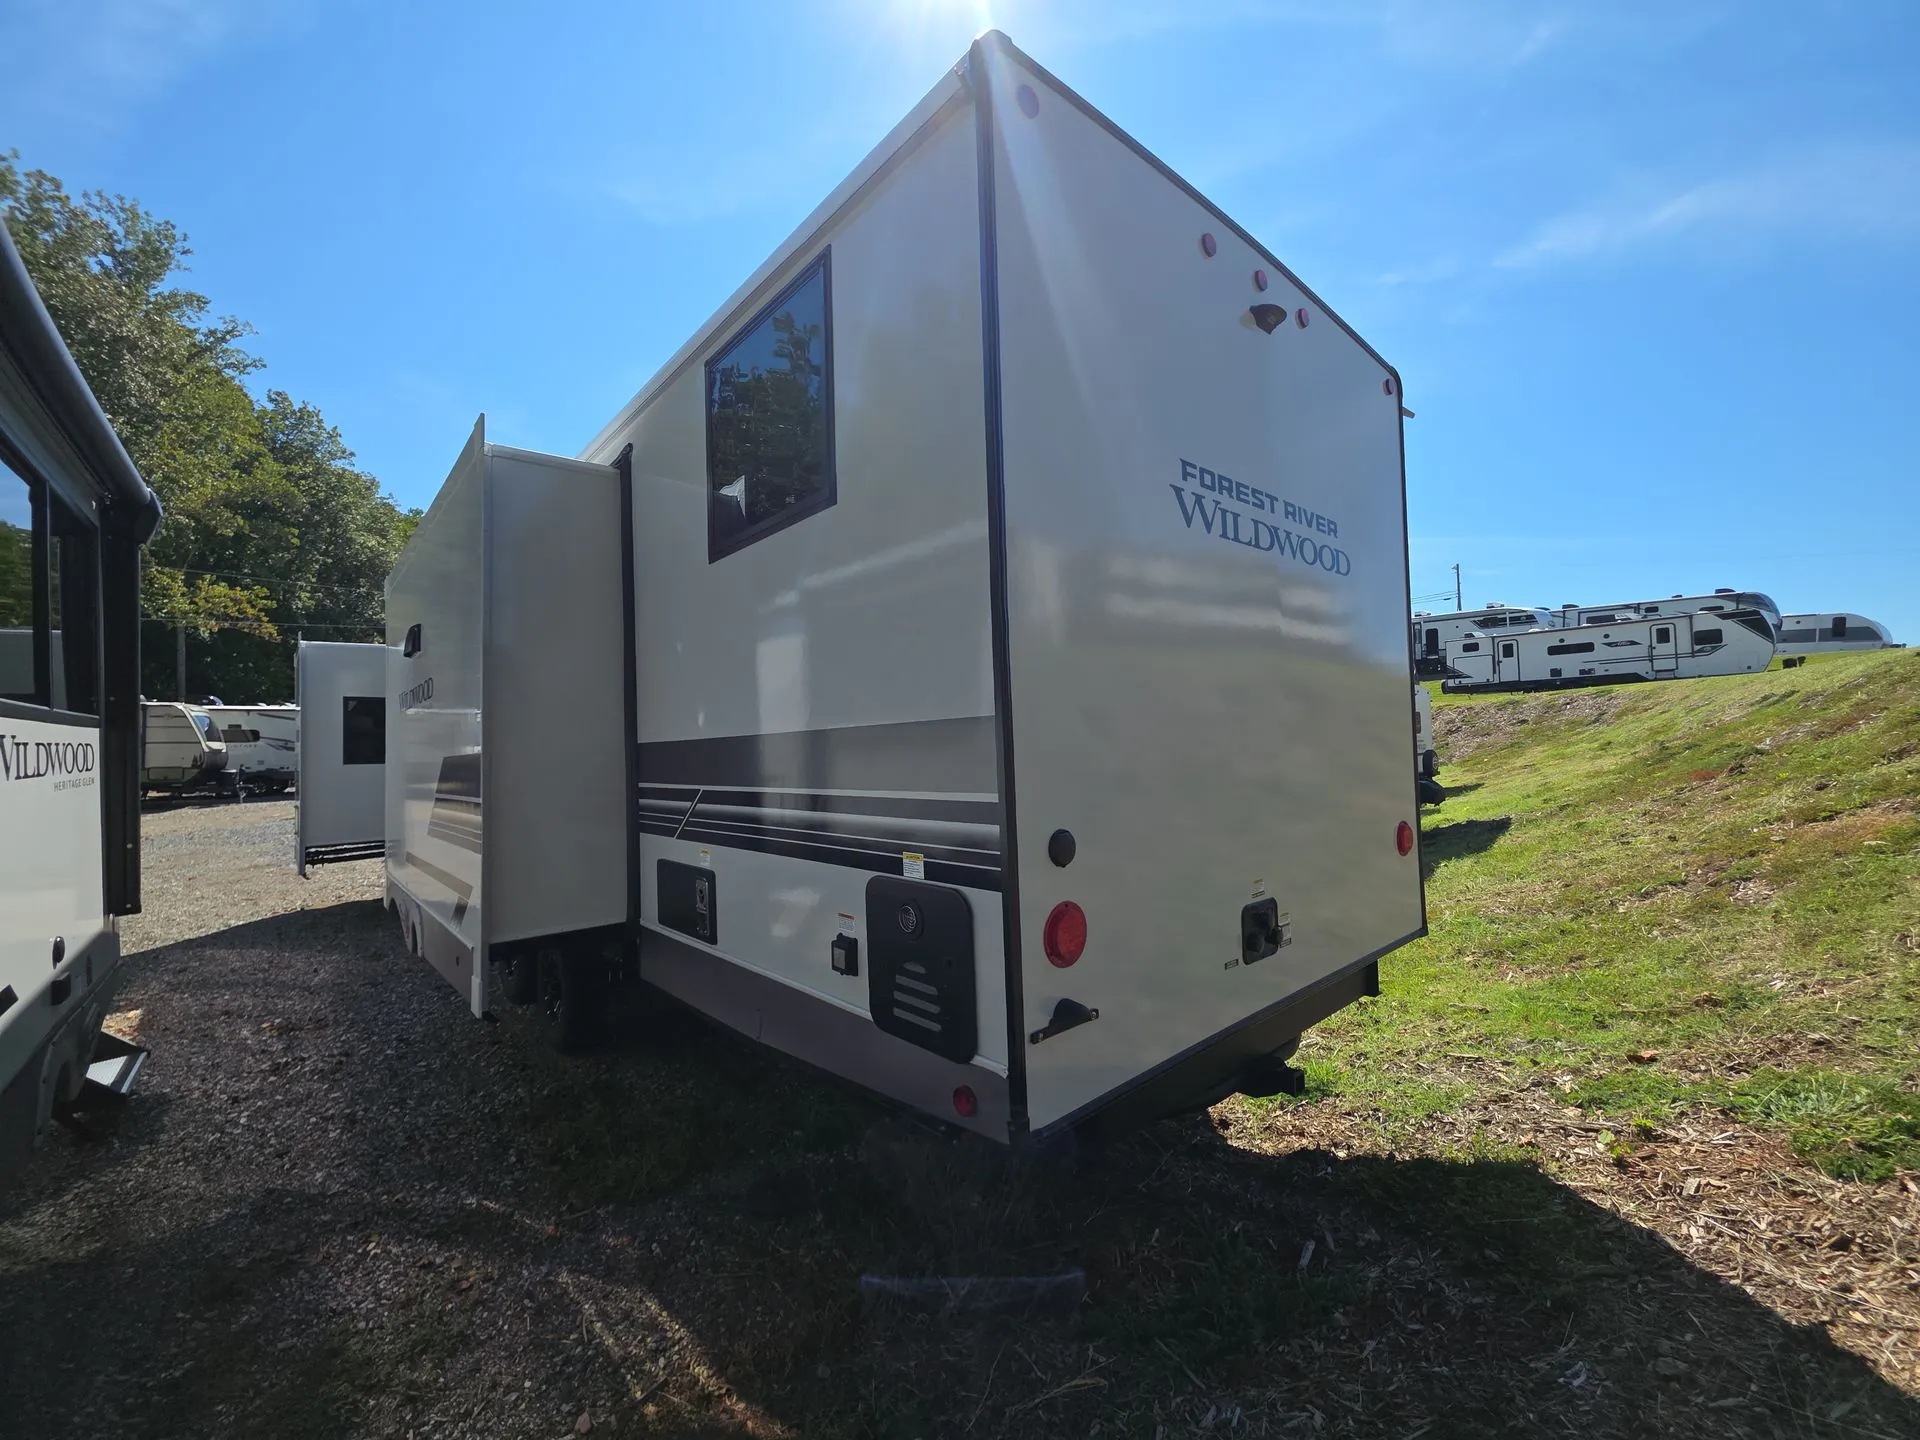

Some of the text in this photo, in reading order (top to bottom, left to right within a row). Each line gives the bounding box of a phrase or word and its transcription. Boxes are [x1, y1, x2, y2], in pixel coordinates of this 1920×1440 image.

[1169, 484, 1351, 577] WILDWOOD
[1179, 457, 1338, 539] FOREST RIVER
[53, 776, 95, 793] HERITAGE GLEN
